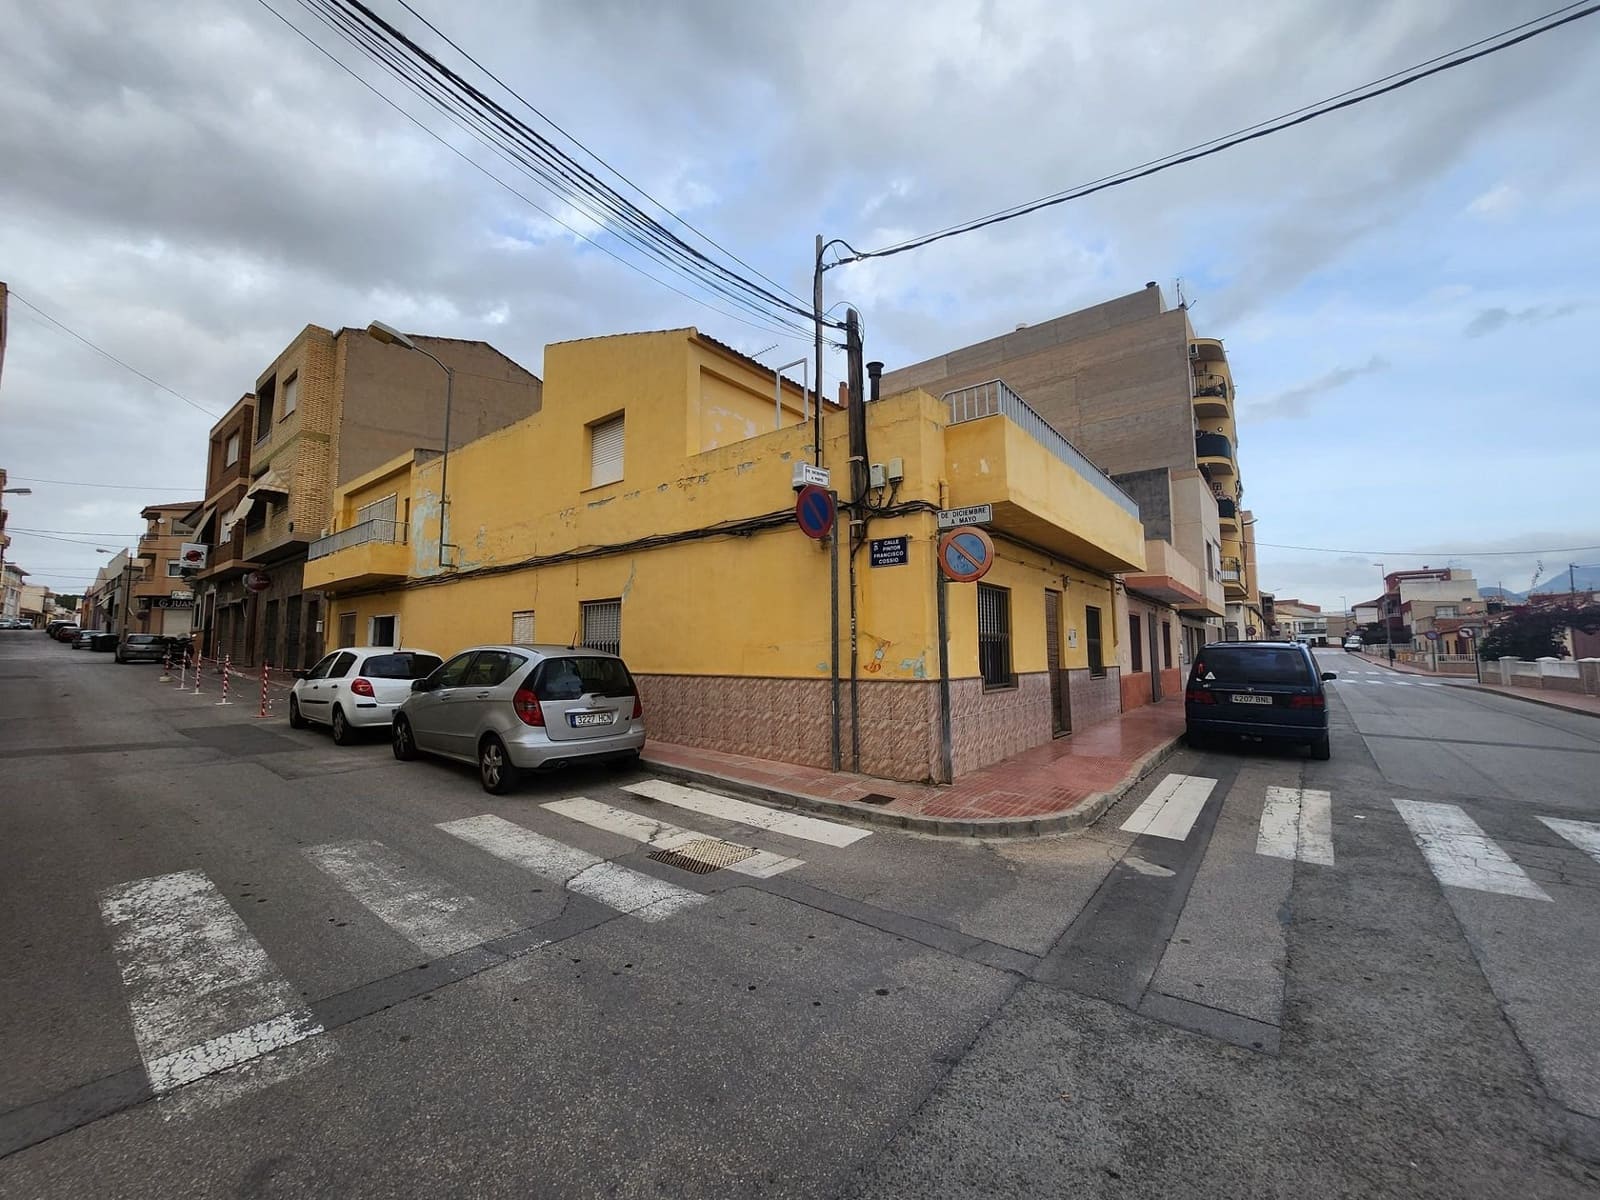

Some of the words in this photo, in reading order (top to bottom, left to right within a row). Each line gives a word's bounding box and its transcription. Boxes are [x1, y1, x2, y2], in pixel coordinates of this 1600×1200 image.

[952, 507, 986, 518] DICIEMBRE
[959, 515, 977, 523] MAYO
[873, 550, 904, 558] FRANCISCO
[1255, 696, 1271, 704] BNL
[577, 714, 595, 724] 3227
